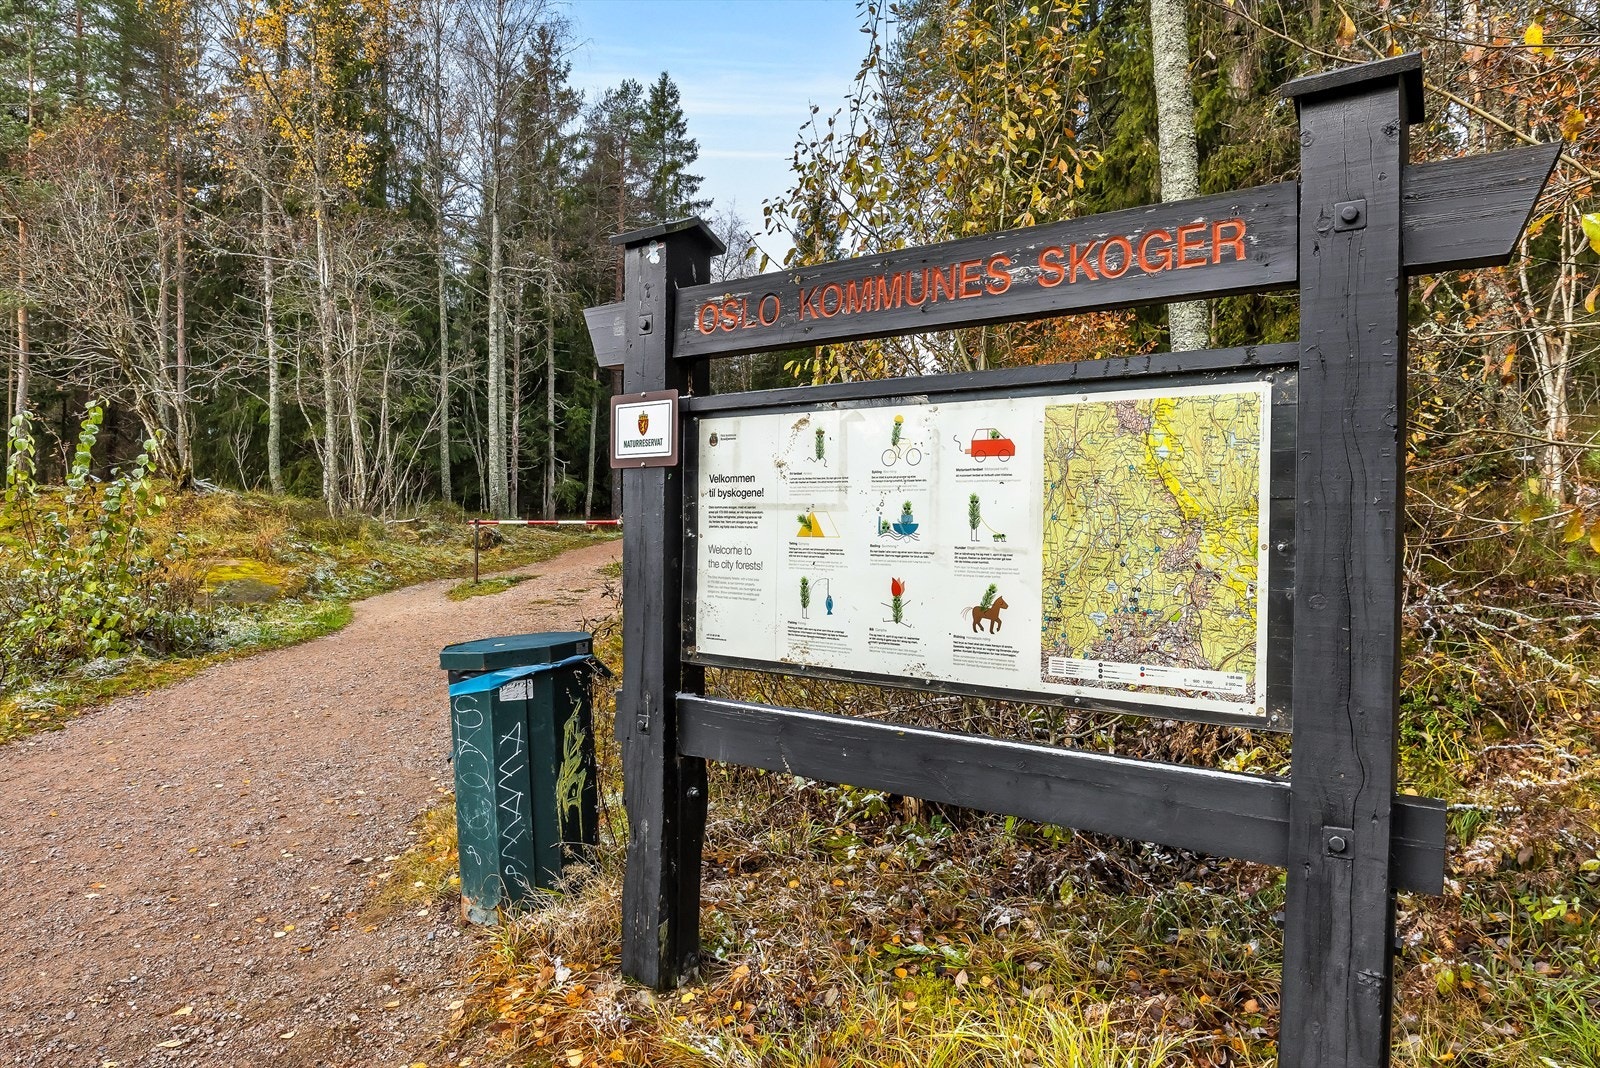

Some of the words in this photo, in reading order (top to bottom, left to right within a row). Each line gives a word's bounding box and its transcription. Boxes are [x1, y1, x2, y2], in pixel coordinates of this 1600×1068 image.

[698, 292, 781, 335] OSLO
[799, 254, 1012, 321] KOMMUNES
[1037, 217, 1247, 288] SKOGER
[623, 438, 663, 448] NATURRESERVAT
[709, 474, 755, 483] Velkommen
[717, 487, 764, 499] byskogene!
[708, 544, 742, 555] Welcome
[744, 546, 752, 556] to
[708, 559, 720, 568] the
[721, 560, 734, 571] city
[735, 560, 763, 571] forests!
